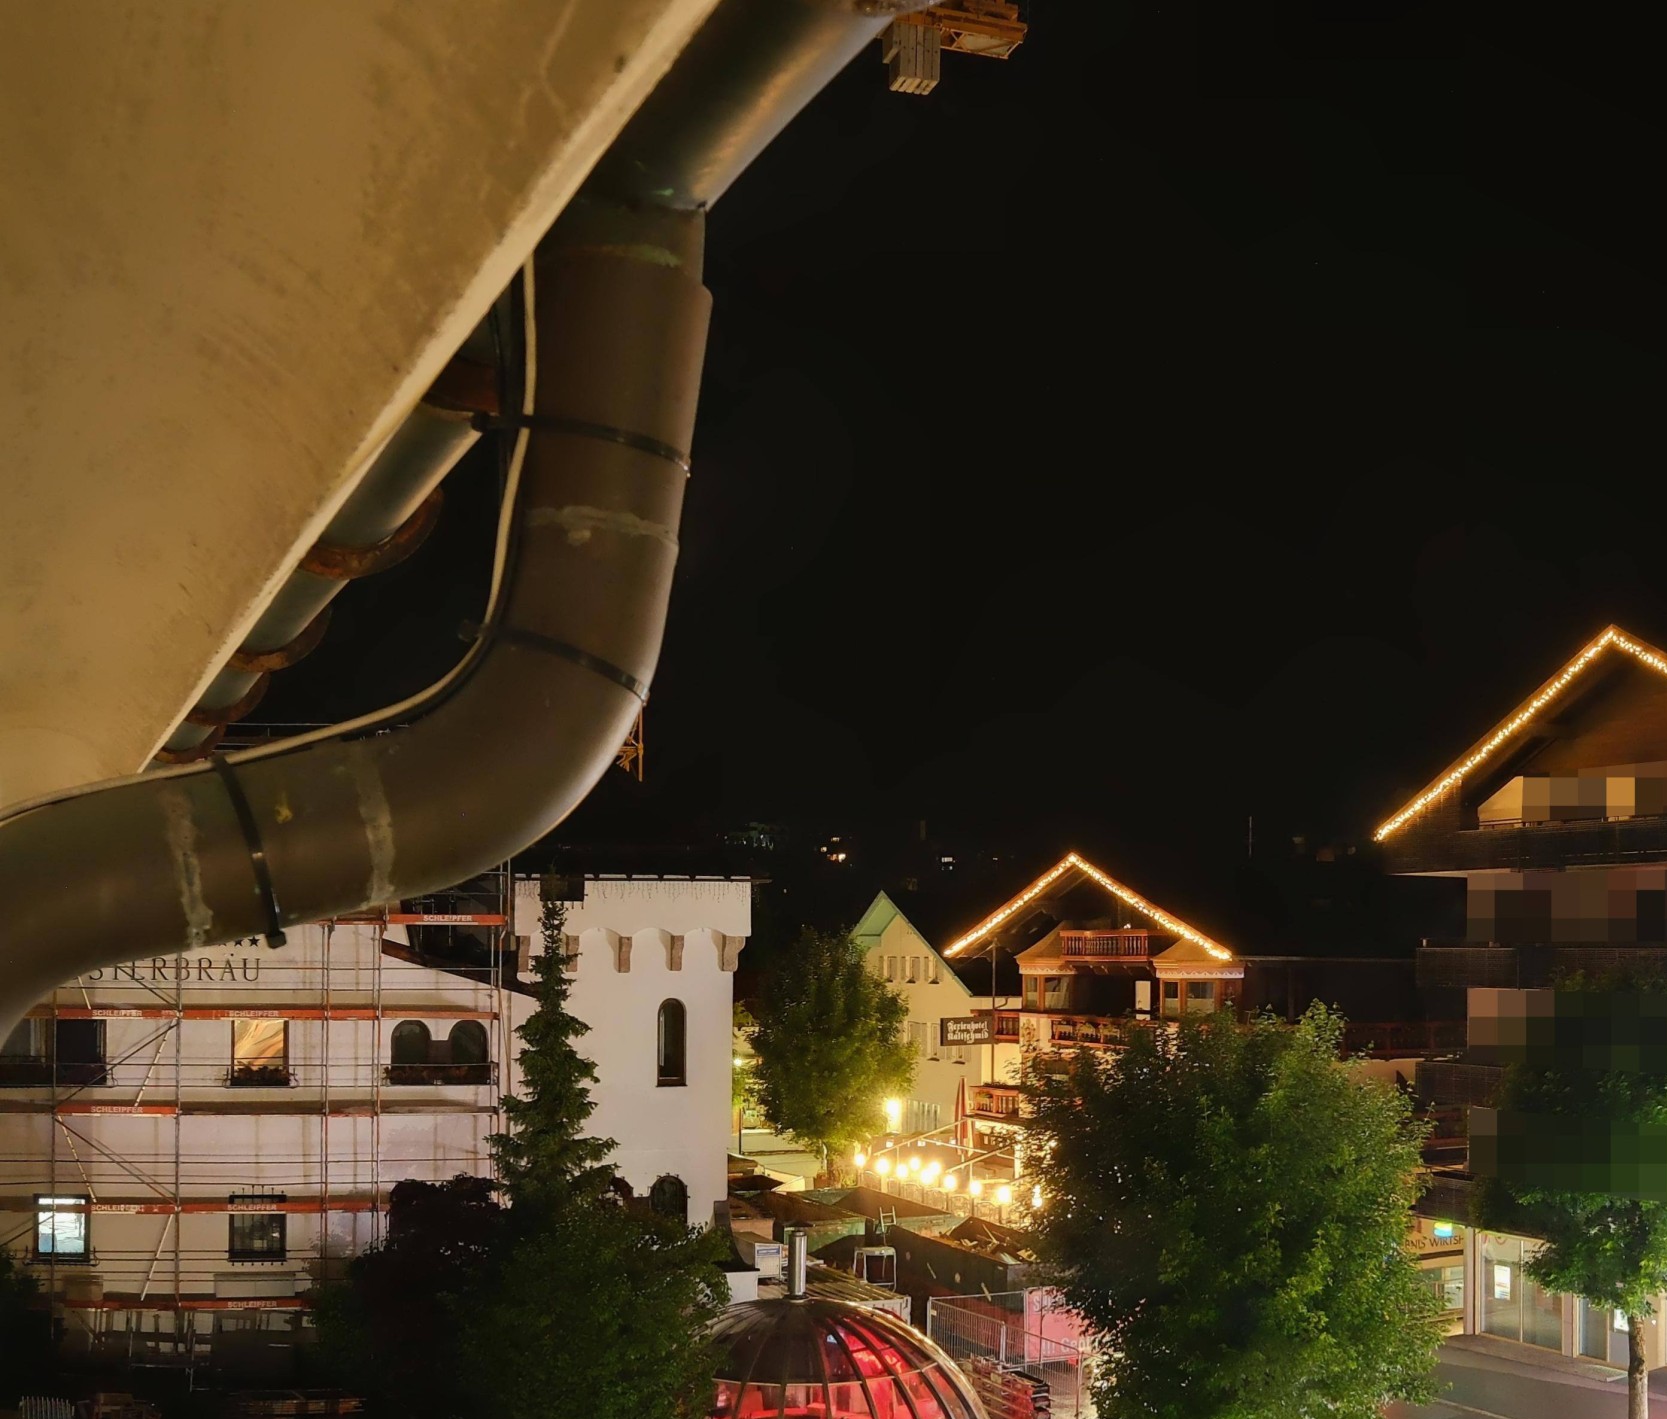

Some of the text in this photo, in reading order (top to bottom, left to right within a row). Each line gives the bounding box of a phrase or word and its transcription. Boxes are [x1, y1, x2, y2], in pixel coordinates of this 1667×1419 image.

[423, 914, 473, 922] SCHLEIPFER
[92, 1010, 143, 1018] SCHLEIPFER
[229, 1010, 280, 1018] SCHLEIPFER
